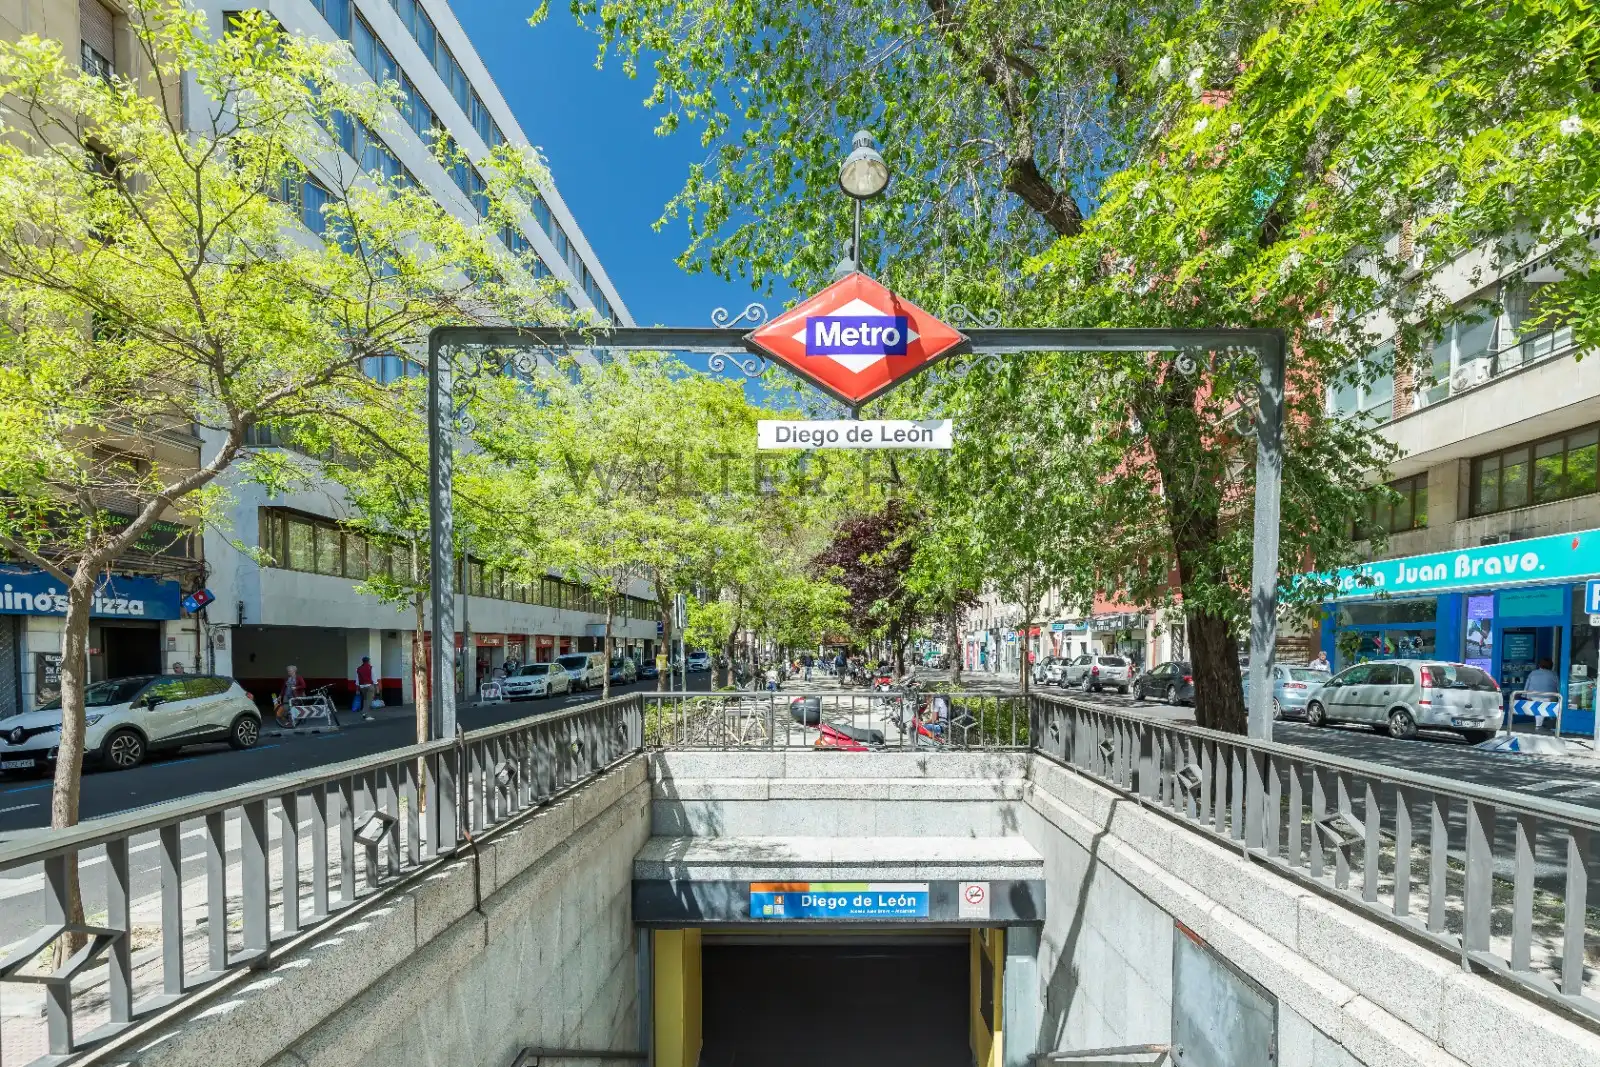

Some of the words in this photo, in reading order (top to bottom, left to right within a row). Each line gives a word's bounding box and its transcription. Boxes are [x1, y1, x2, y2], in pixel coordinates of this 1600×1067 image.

[815, 321, 900, 347] Metro
[776, 425, 839, 447] Diego
[846, 425, 873, 443] de
[881, 424, 933, 443] León
[1395, 562, 1447, 585] Juan
[1454, 552, 1546, 579] Bravo.
[90, 590, 145, 616] izza
[801, 894, 847, 909] Diego
[853, 894, 872, 907] de
[879, 894, 916, 907] León
